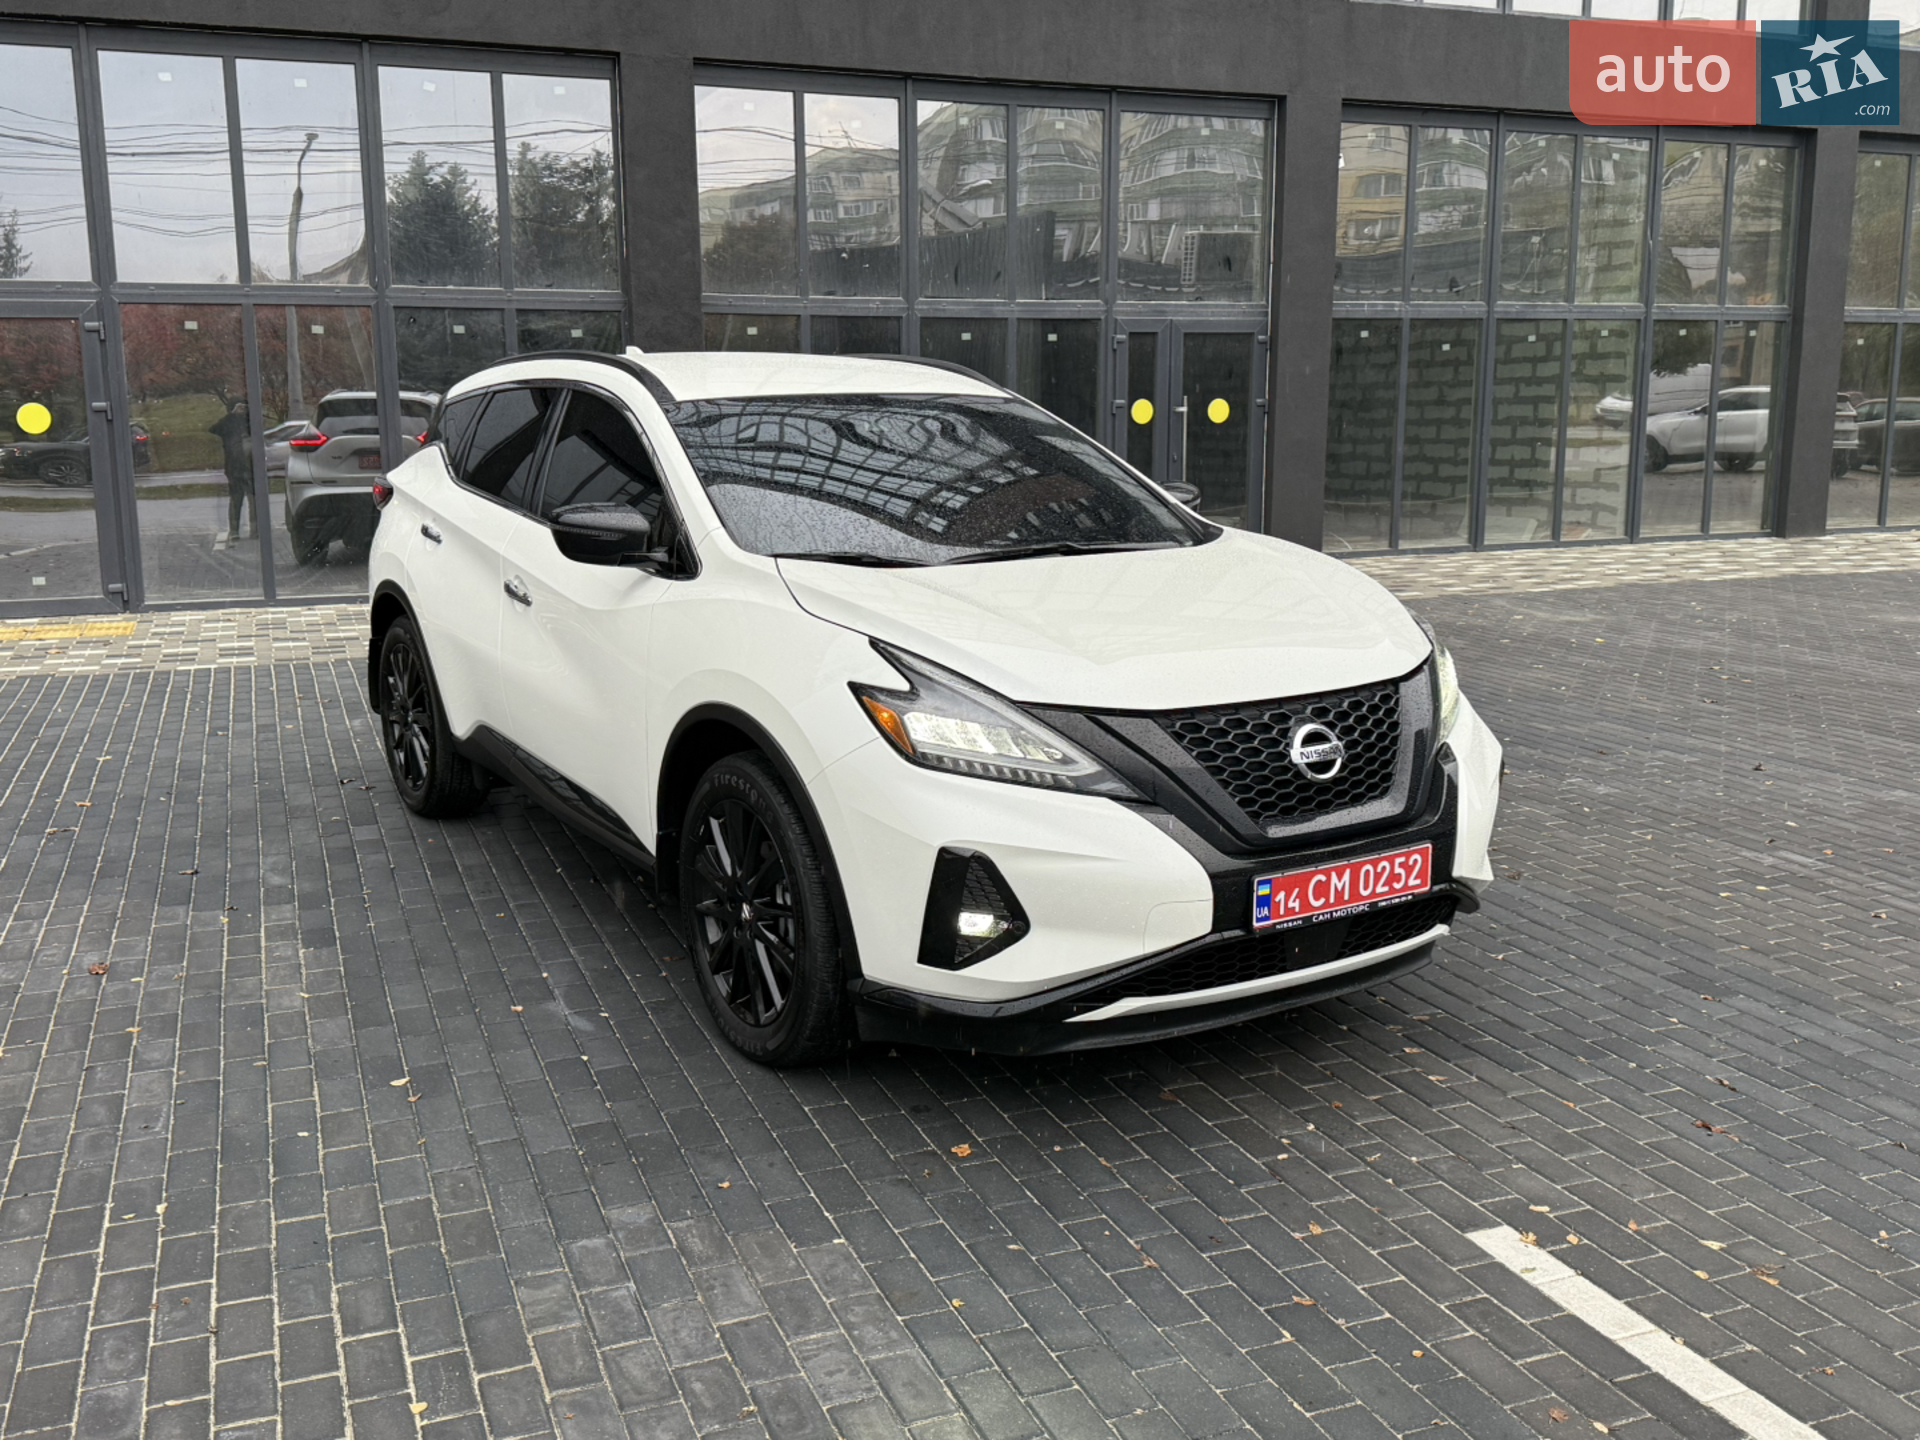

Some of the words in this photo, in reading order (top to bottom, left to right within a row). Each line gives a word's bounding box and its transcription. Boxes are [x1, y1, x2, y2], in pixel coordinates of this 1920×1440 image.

[1300, 744, 1342, 761] NISSAN
[713, 773, 774, 824] Firestone
[1274, 888, 1300, 916] 14
[1307, 868, 1351, 907] CM
[1359, 853, 1423, 897] 0252
[1256, 906, 1270, 918] UA
[1275, 919, 1303, 930] NISSAN
